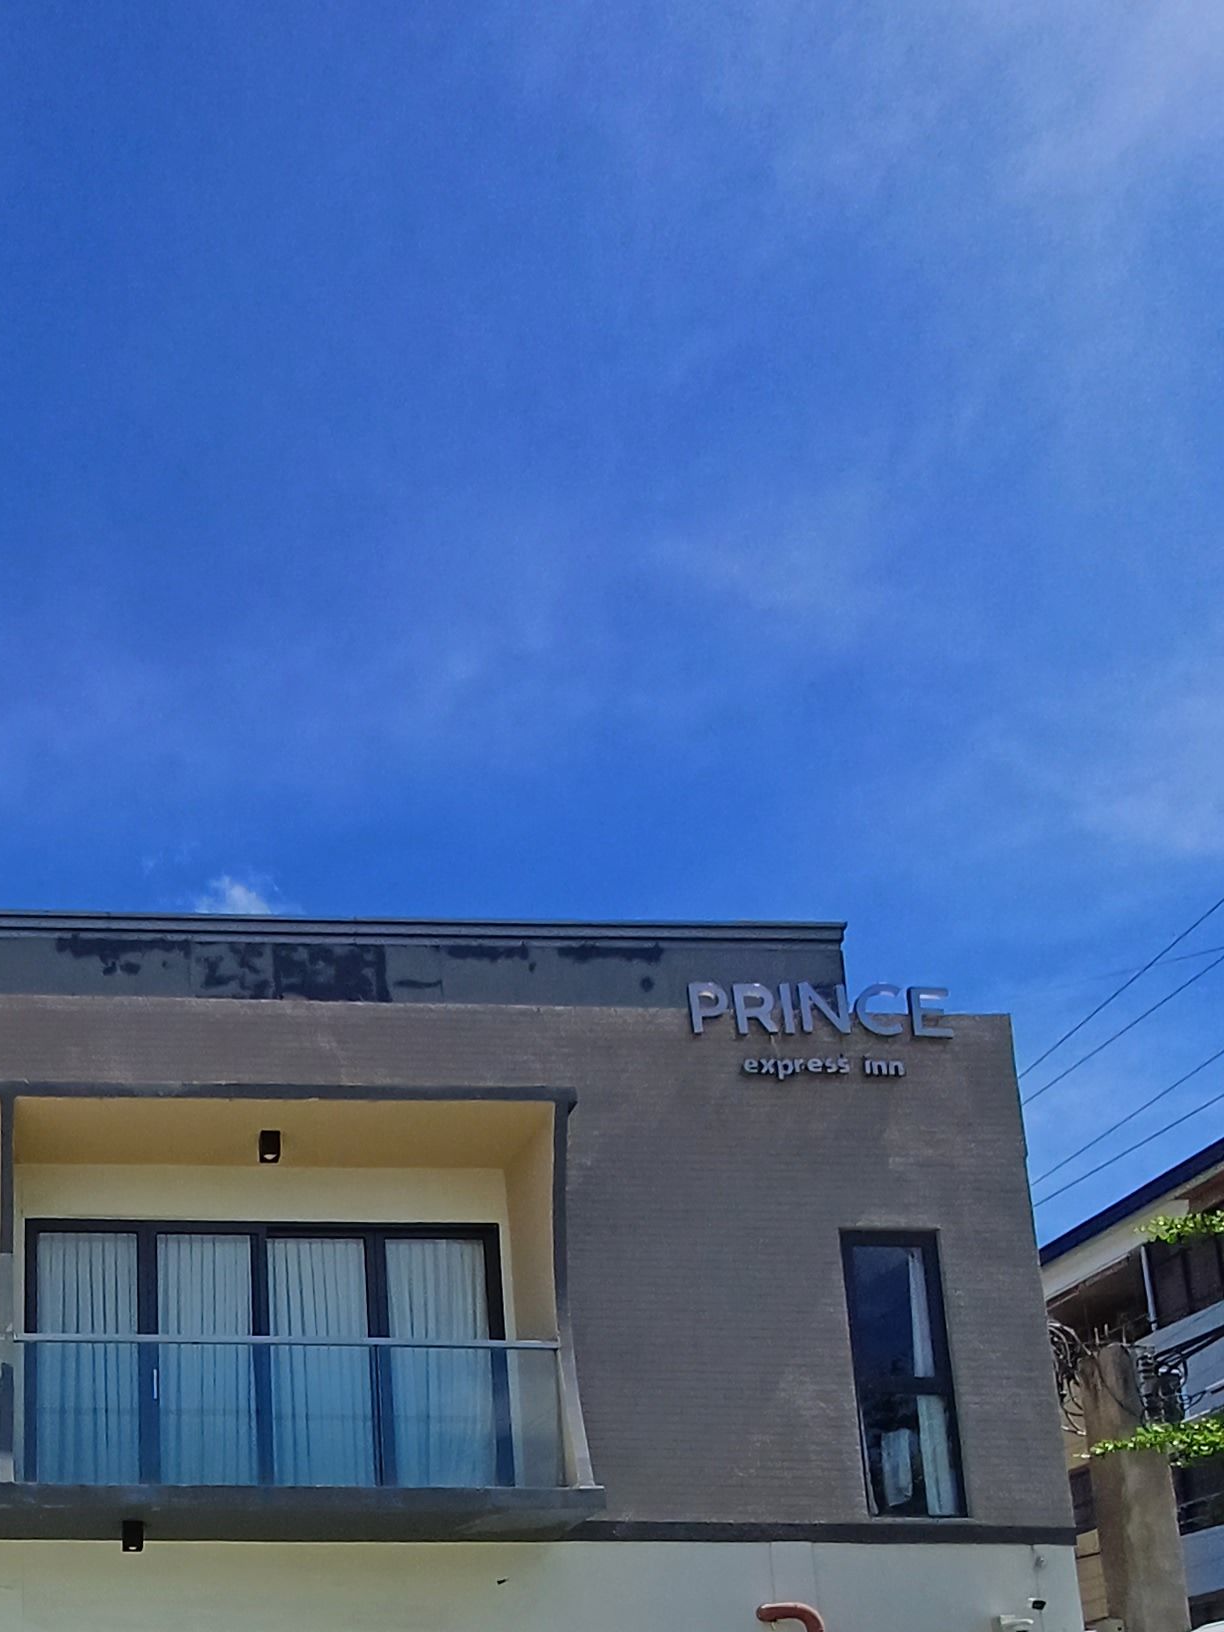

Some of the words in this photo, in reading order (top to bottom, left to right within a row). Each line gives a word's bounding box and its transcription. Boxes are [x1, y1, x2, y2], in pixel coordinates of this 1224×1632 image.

[687, 981, 954, 1038] PRINCE
[742, 1055, 851, 1080] express
[864, 1054, 906, 1076] inn
